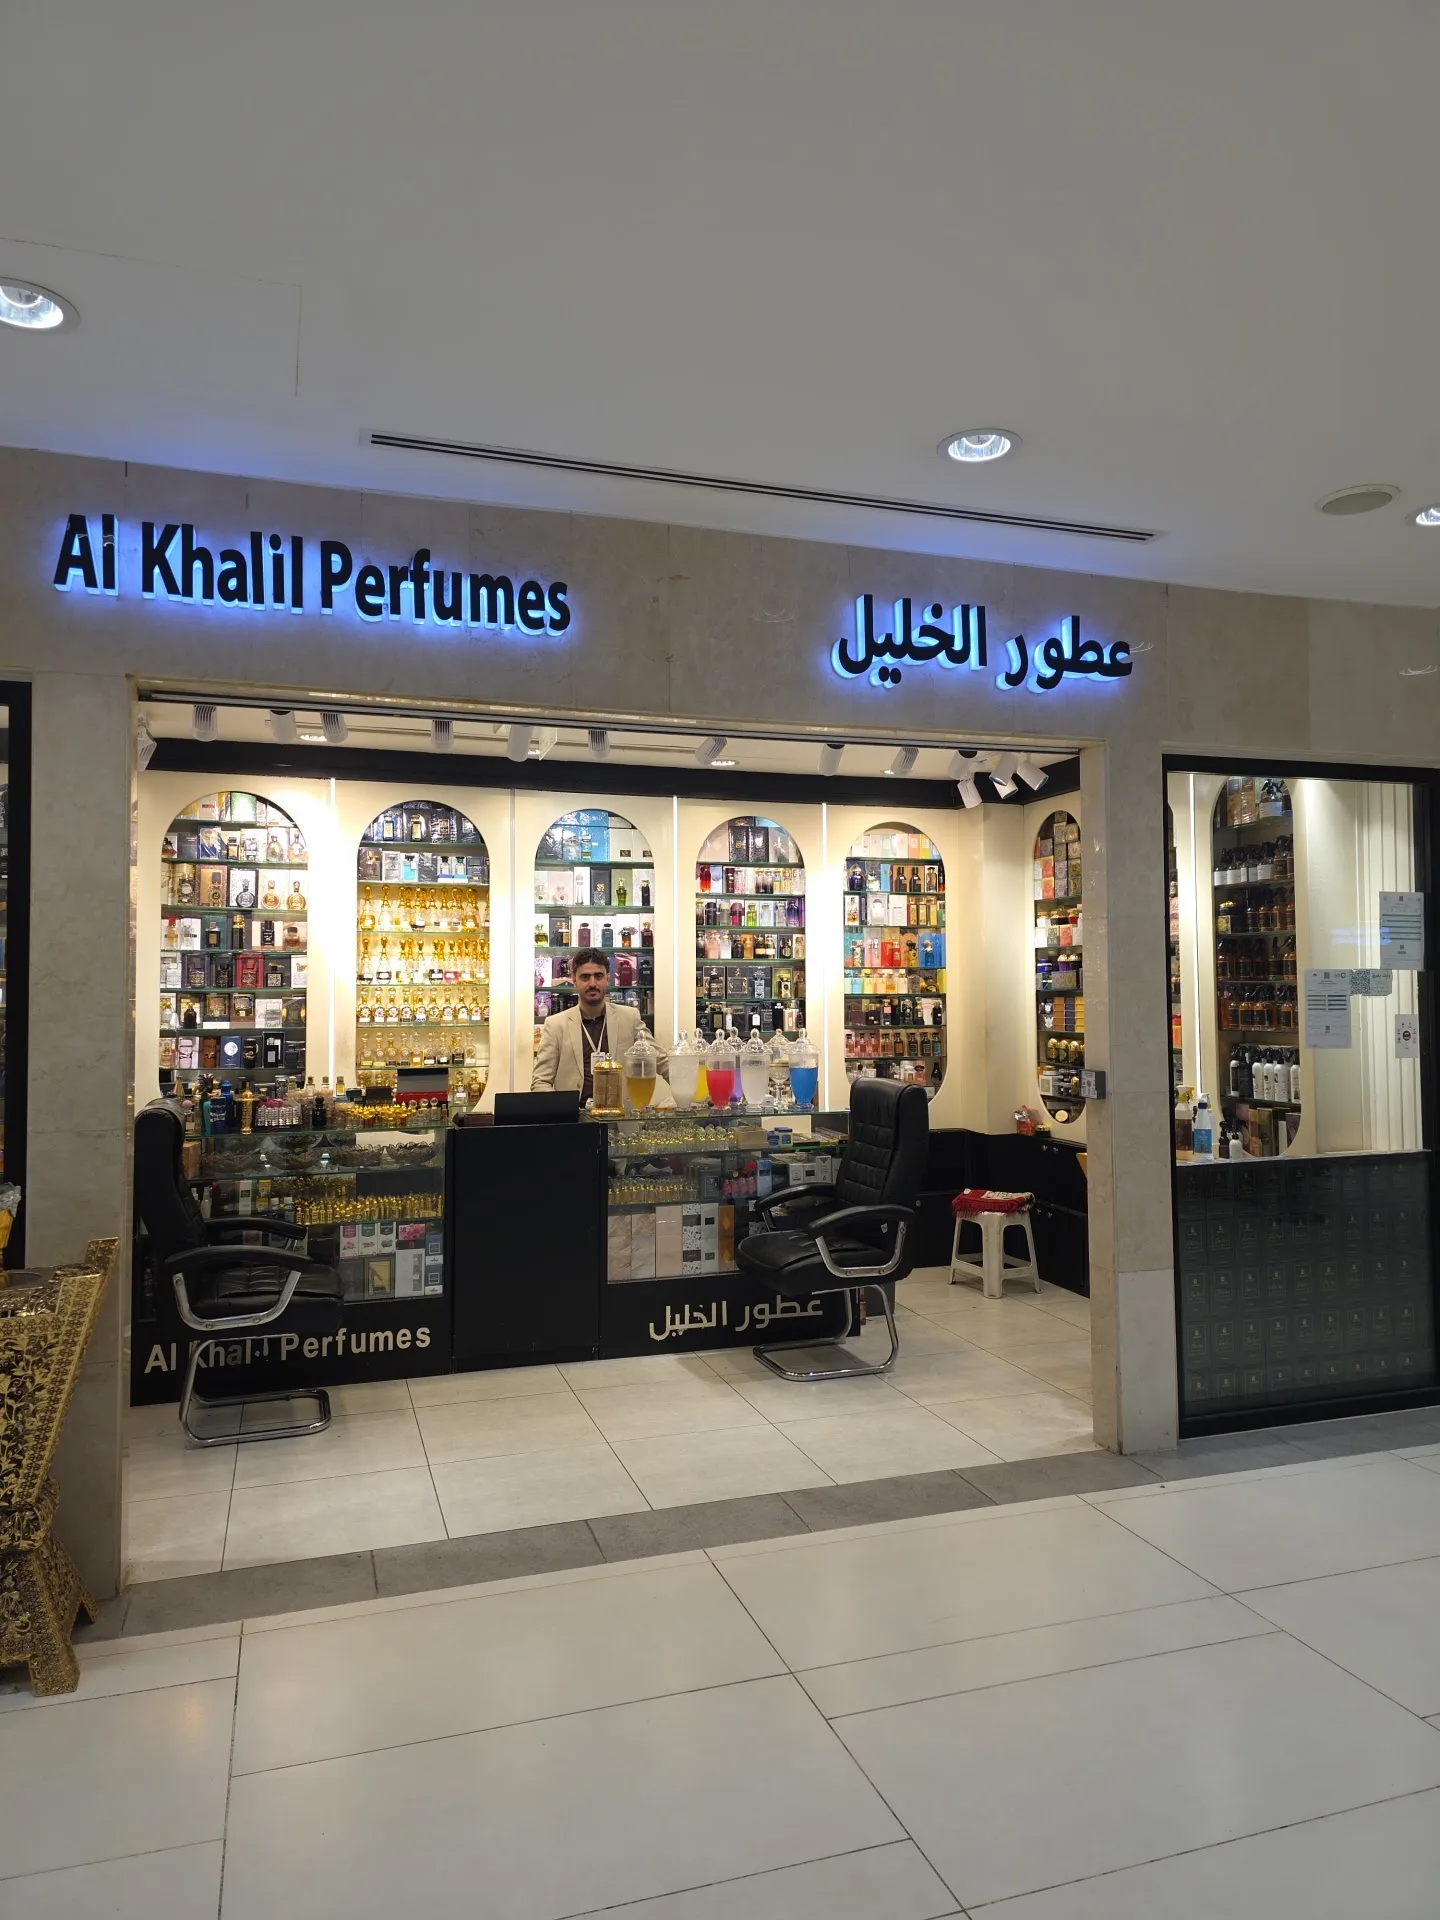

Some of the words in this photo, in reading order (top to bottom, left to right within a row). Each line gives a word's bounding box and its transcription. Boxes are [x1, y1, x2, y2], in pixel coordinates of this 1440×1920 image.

[53, 513, 118, 594] Al
[141, 521, 304, 613] Khalil
[320, 540, 571, 635] Perfumes
[834, 594, 987, 685] الخليل
[1000, 615, 1133, 691] عطور
[648, 1300, 729, 1342] الخليل
[735, 1294, 824, 1332] عطور
[144, 1341, 177, 1374] Al
[188, 1336, 270, 1370] Khall
[281, 1325, 432, 1361] Perfumes
